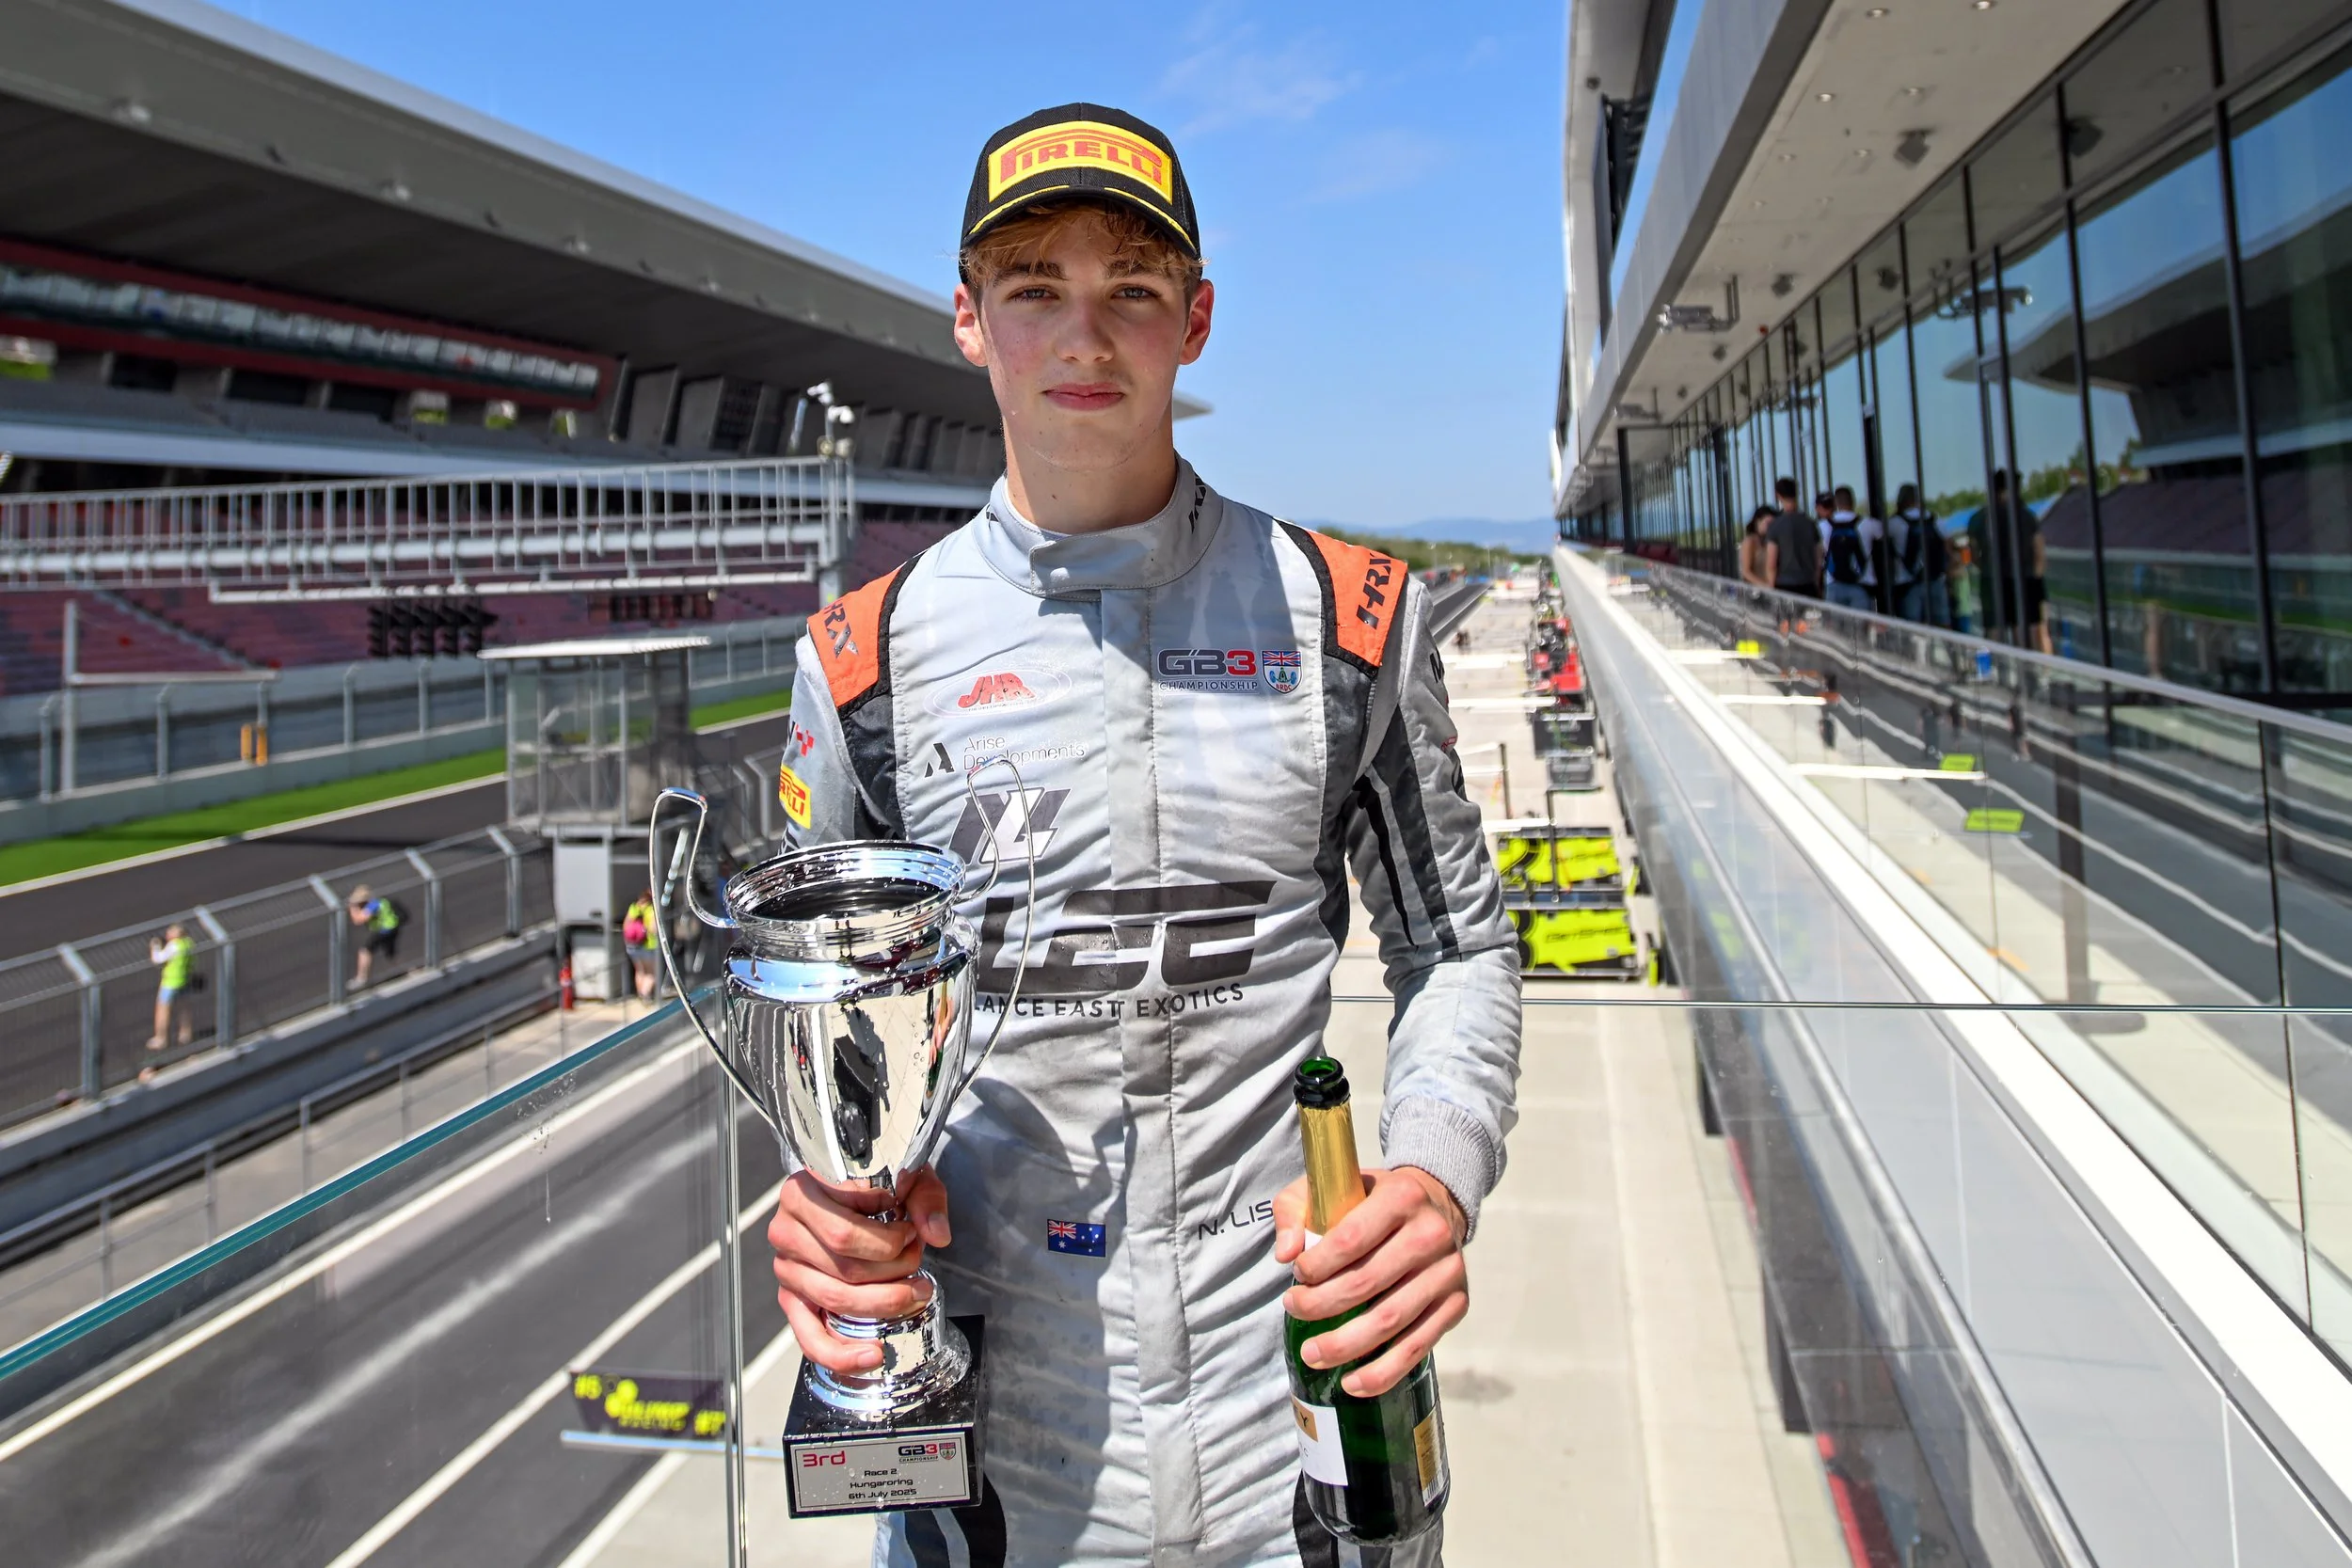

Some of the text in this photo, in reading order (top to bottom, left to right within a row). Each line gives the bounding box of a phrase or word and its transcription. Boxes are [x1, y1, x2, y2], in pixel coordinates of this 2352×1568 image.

[1000, 129, 1163, 184] PIRELLI
[1158, 650, 1257, 676] GB3
[1159, 681, 1258, 691] CHAMPIONSHIP
[963, 736, 1006, 752] Arise
[963, 744, 1085, 770] Delopments
[1137, 983, 1244, 1018] EXOTICS
[1199, 1219, 1225, 1240] N.
[898, 1443, 938, 1456] GB3
[803, 1450, 846, 1467] 3rd
[850, 1479, 914, 1489] Hungaroring
[867, 1490, 888, 1498] July
[890, 1488, 917, 1497] 2025
